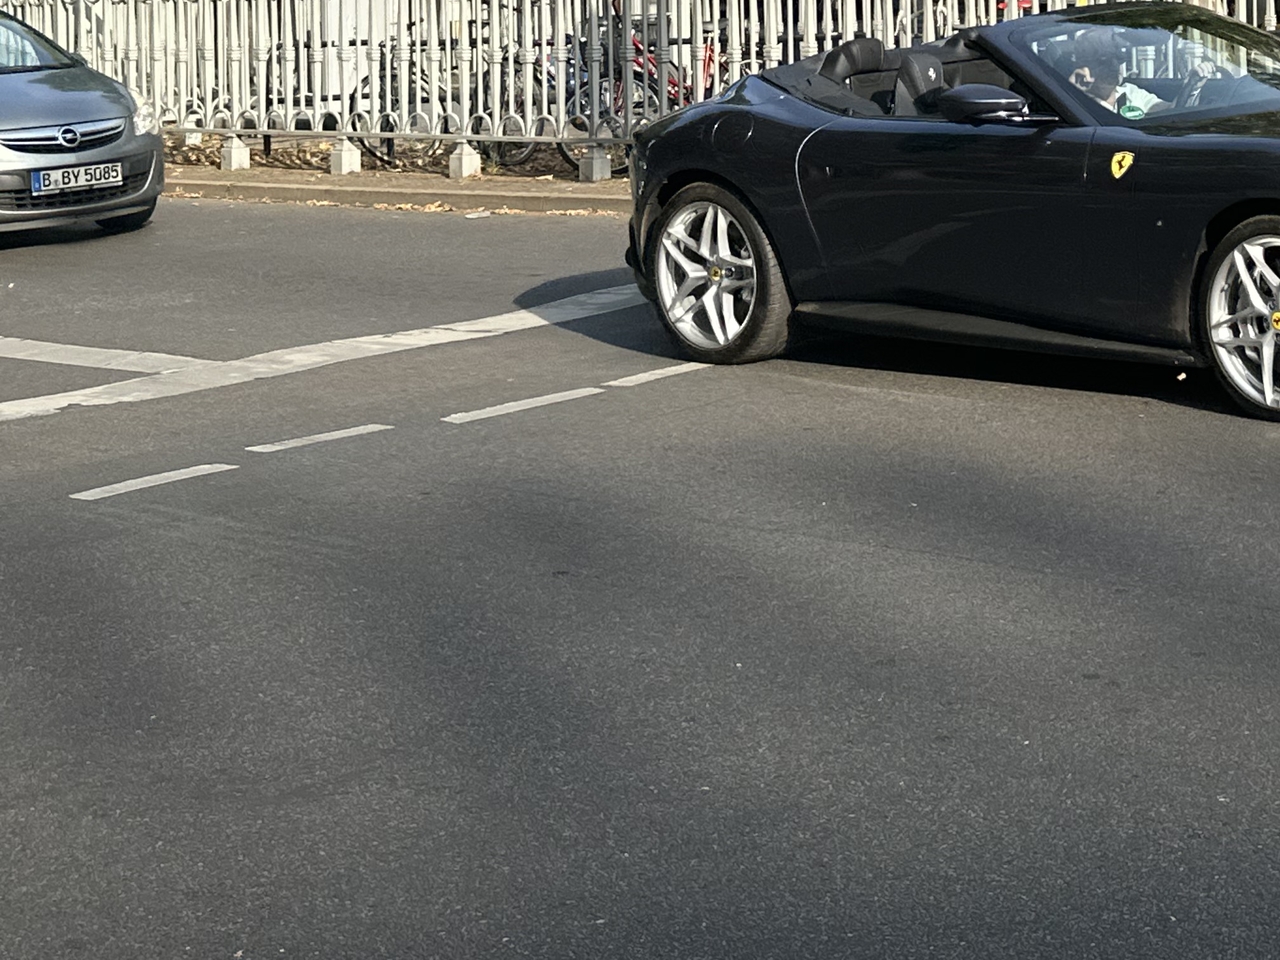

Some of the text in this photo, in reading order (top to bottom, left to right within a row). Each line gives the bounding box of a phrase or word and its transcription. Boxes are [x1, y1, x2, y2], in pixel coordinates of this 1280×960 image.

[43, 165, 119, 187] B BY 5085
